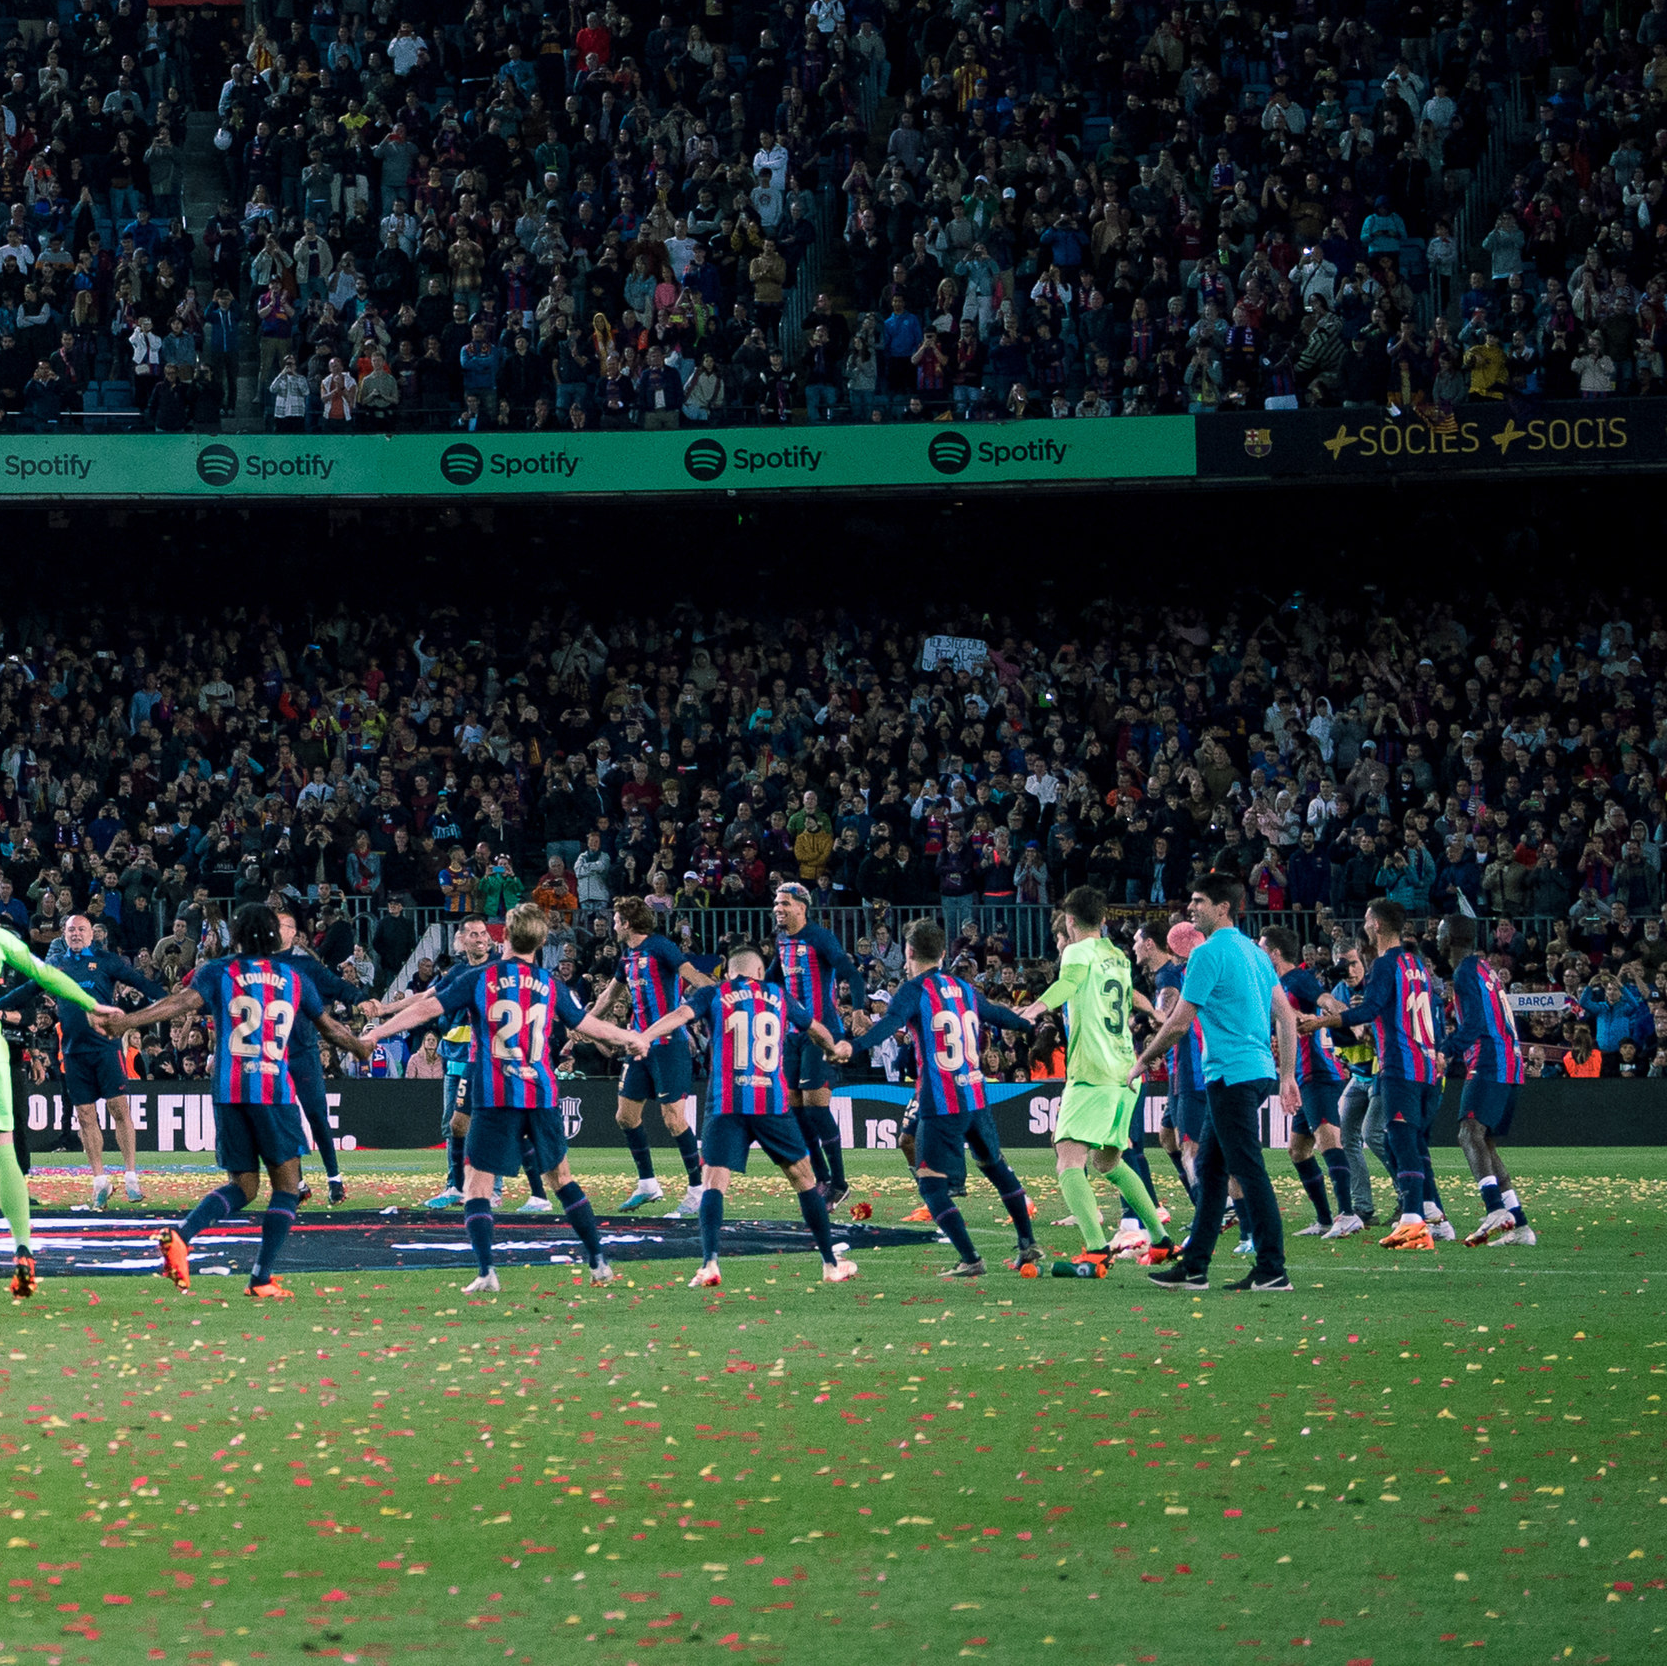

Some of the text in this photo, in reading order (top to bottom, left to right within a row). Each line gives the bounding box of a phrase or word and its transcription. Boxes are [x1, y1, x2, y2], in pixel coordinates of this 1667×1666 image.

[490, 451, 578, 478] Spotify
[733, 445, 822, 472] Spotify
[978, 438, 1067, 466] Spotify
[5, 454, 91, 479] Spotify
[246, 453, 334, 480] Spotify
[234, 972, 288, 991] KOUNDE
[500, 975, 517, 989] DE
[519, 974, 550, 997] JONG
[720, 991, 782, 1010] JORDI ALBA
[1103, 979, 1132, 1035] 3
[1518, 997, 1555, 1007] BARÇA
[228, 995, 295, 1061] 23
[1406, 991, 1435, 1044] 11
[488, 999, 547, 1064] 21
[724, 1010, 781, 1072] 18
[458, 1078, 468, 1097] 5
[865, 1118, 897, 1149] IS
